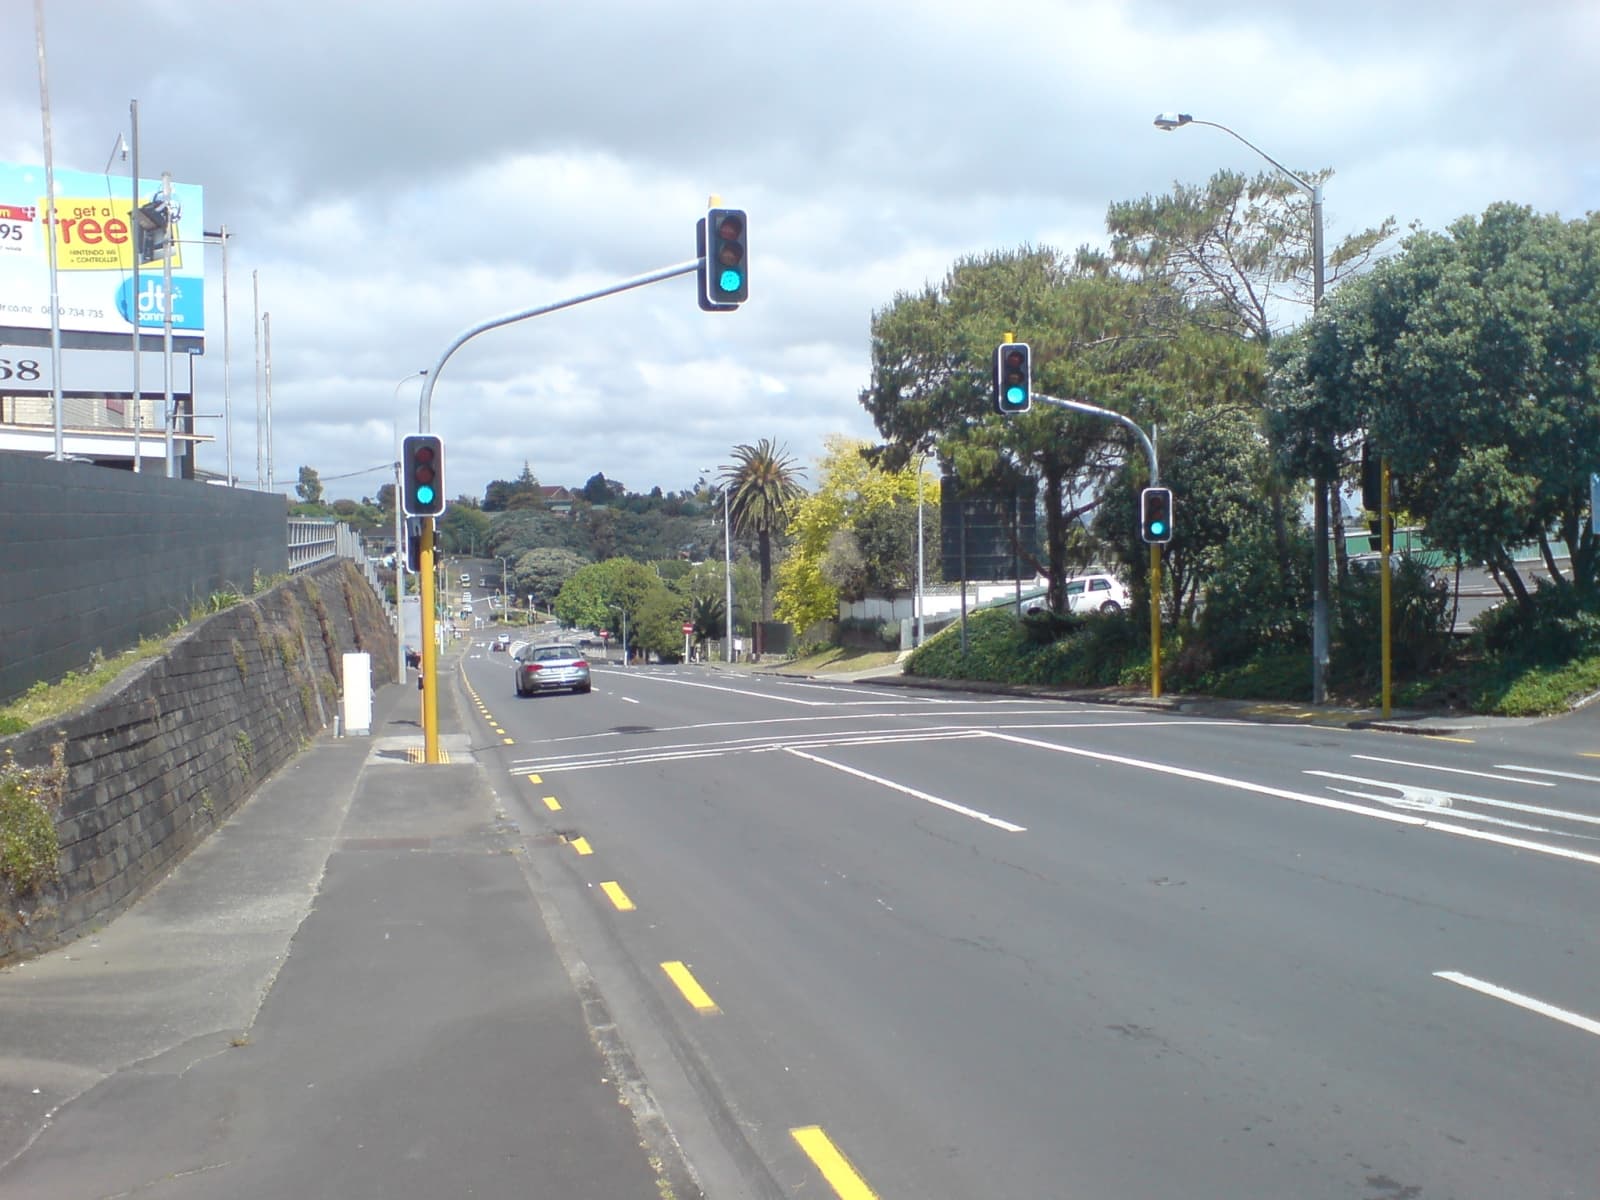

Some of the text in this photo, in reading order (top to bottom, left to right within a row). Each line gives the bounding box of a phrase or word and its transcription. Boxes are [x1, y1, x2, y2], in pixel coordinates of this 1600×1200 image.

[73, 206, 111, 219] get a
[0, 223, 23, 241] 95
[42, 207, 128, 244] free
[138, 279, 178, 312] dtr
[68, 307, 85, 317] 734
